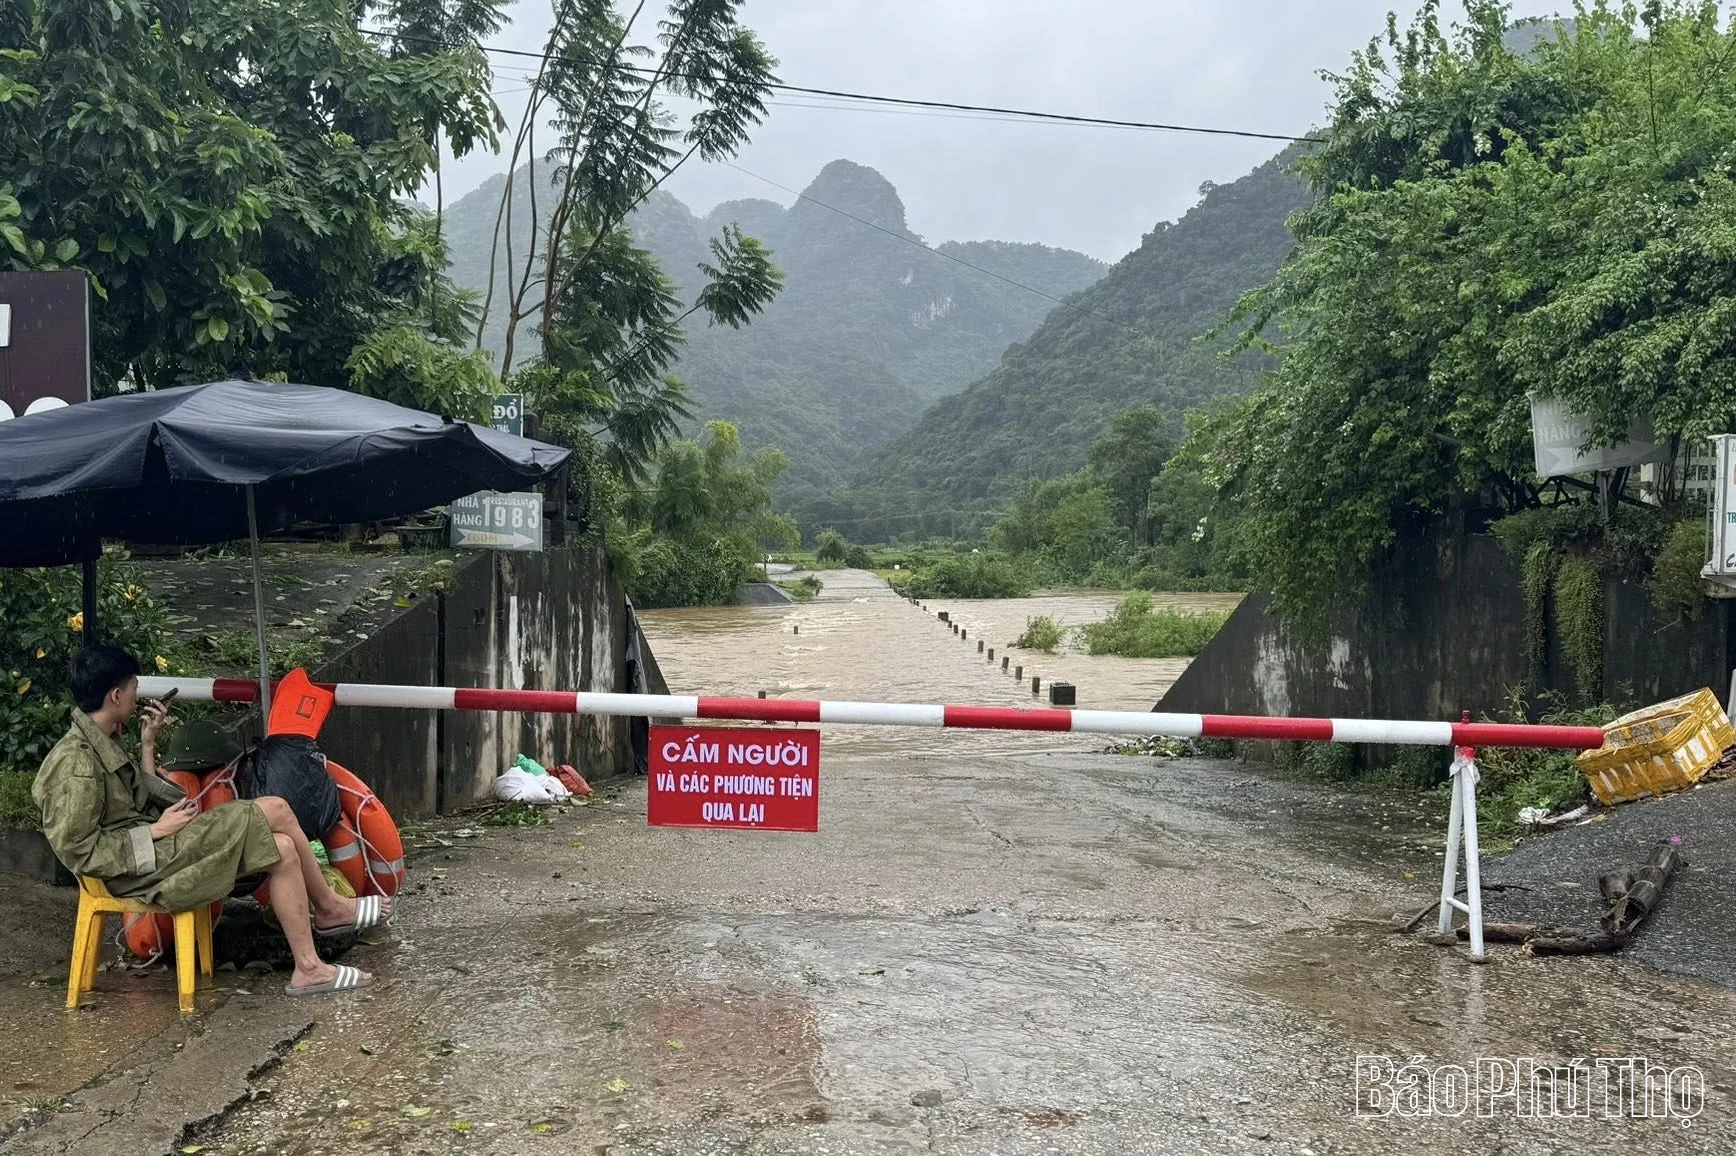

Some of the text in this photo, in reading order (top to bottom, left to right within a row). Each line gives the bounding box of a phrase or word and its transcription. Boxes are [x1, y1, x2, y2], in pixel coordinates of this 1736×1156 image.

[457, 494, 479, 508] NHÀ
[482, 496, 540, 529] 1983
[453, 511, 482, 526] HÀNG
[662, 734, 808, 767] CẤM NGƯỜI
[656, 770, 813, 800] VÀ CÁC PHƯƠNG TIỆN
[702, 802, 765, 826] QUA LẠI
